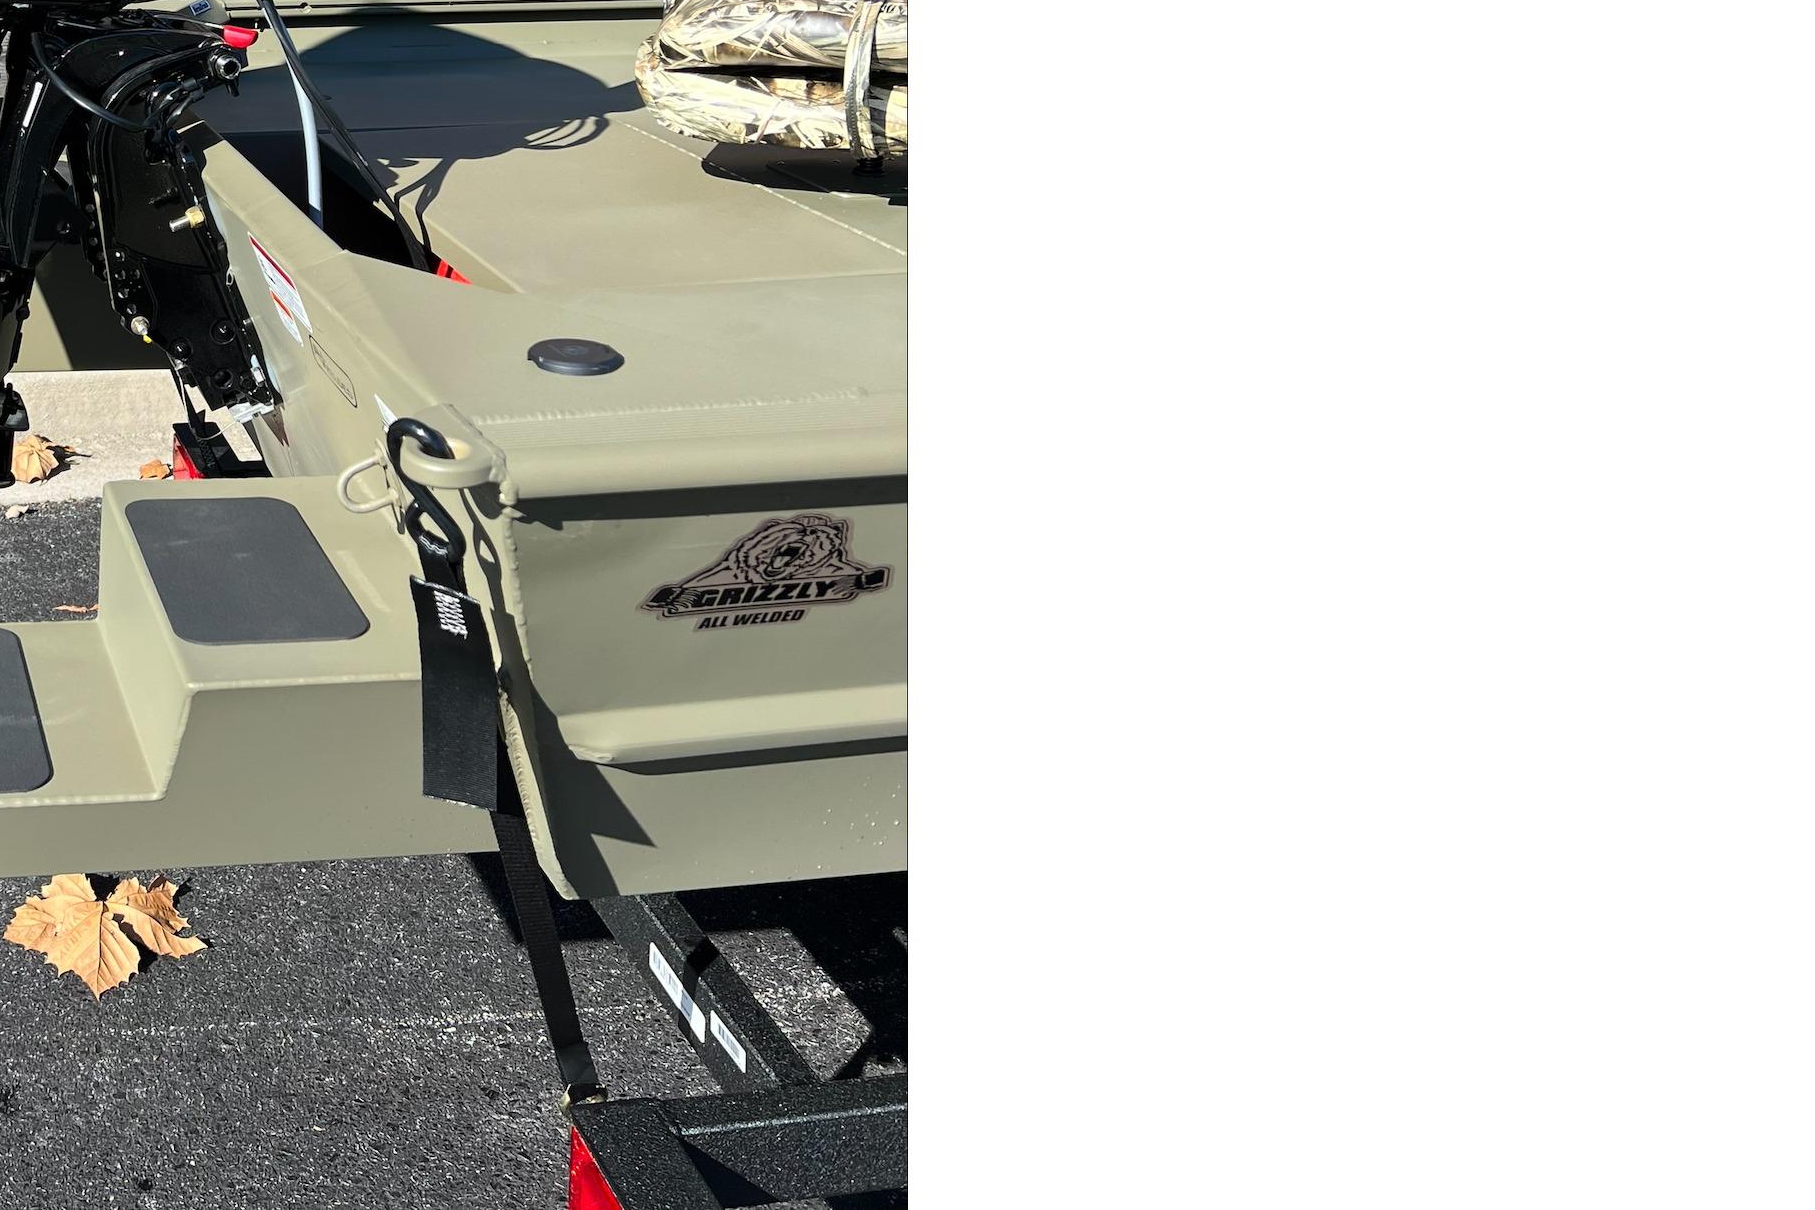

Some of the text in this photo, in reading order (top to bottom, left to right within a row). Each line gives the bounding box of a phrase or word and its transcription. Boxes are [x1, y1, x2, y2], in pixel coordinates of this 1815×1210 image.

[692, 580, 837, 608] GRIZZLY
[698, 608, 806, 630] ALL WELDED
